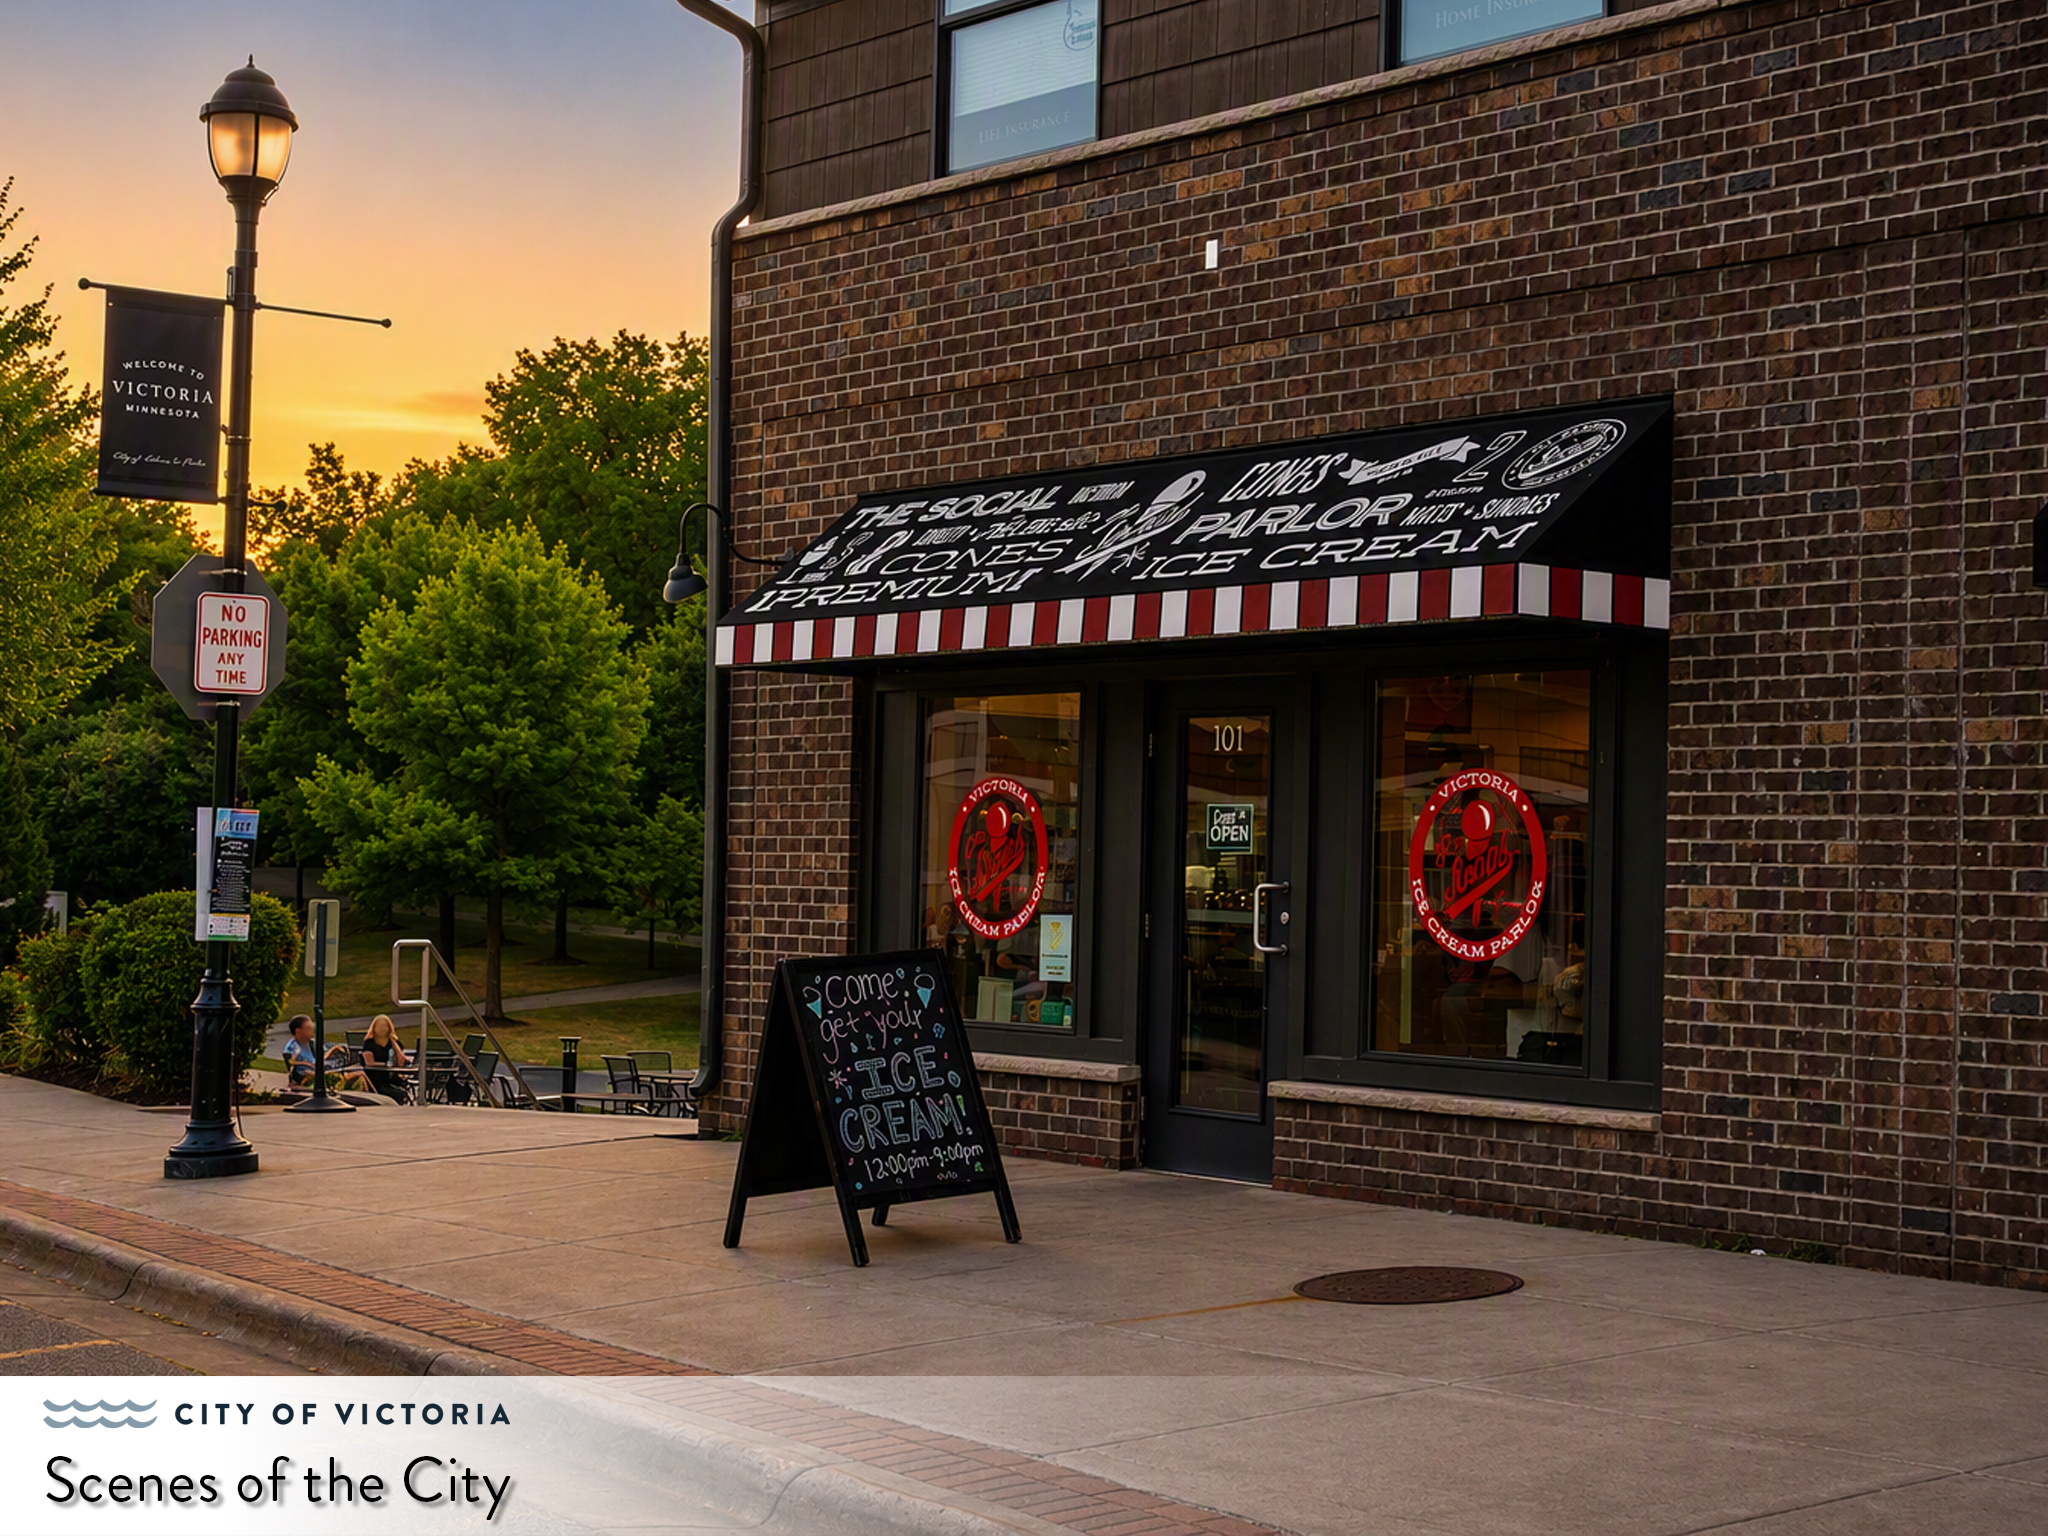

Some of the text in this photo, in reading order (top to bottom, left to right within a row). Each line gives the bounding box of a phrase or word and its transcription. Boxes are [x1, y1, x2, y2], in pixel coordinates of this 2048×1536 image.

[122, 360, 205, 381] WELCOME TO
[112, 380, 214, 404] VICTORIA
[125, 404, 200, 419] MINNESOTA
[845, 500, 929, 531] THE
[917, 485, 1063, 522] SOCIAL
[1170, 492, 1414, 546] PARLOR
[879, 538, 1074, 576] CONES
[1130, 521, 1538, 581] ICE CREAM
[221, 604, 246, 623] NO
[202, 627, 262, 648] PARKING
[217, 652, 245, 665] ANY
[215, 669, 247, 685] TIME
[1213, 724, 1244, 753] 101
[1439, 772, 1518, 802] VICTORIA
[1210, 825, 1249, 842] OPEN
[1427, 917, 1485, 958] CREAM
[819, 1000, 923, 1065] get your
[854, 1045, 946, 1100] ICE
[839, 1093, 974, 1153] CREAM!
